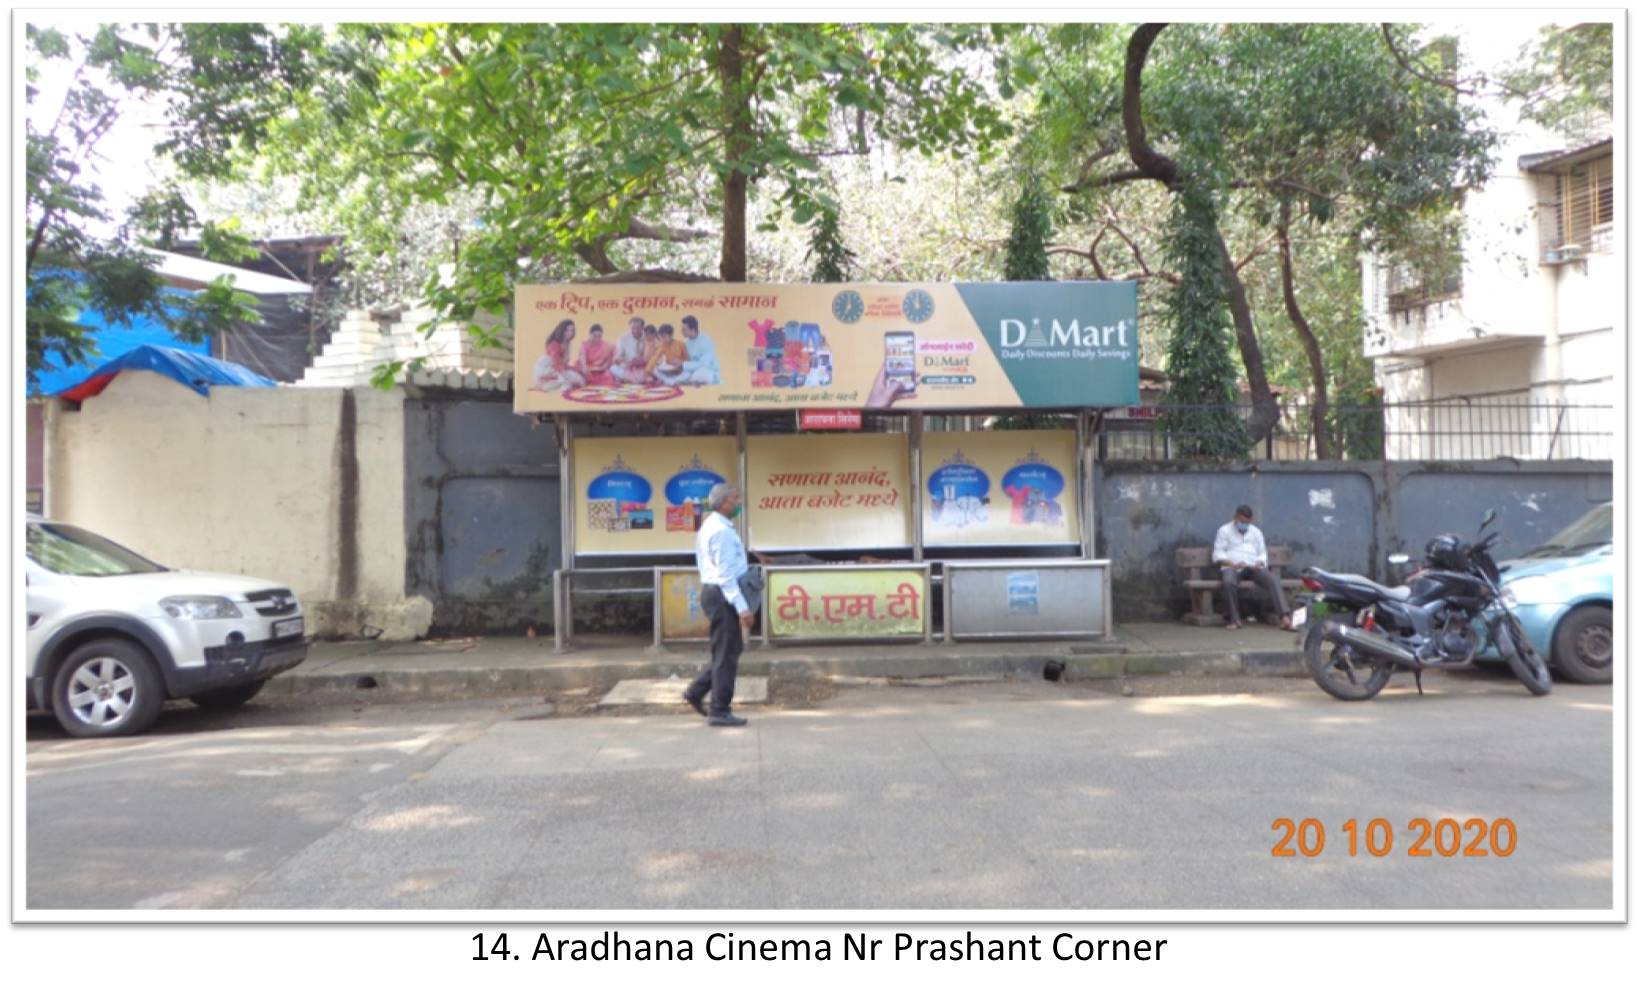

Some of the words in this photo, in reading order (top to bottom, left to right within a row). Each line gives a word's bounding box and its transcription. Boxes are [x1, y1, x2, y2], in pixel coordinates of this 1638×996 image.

[718, 295, 777, 308] सामान
[1001, 349, 1024, 361] Daily
[1026, 349, 1071, 358] Discounts
[1072, 349, 1096, 360] Daily
[1097, 348, 1132, 360] Savings
[768, 472, 832, 487] सणाचा
[834, 465, 891, 487] आनंद,
[758, 495, 803, 509] आता
[806, 489, 853, 508] बजेट
[855, 487, 900, 507] मध्ये
